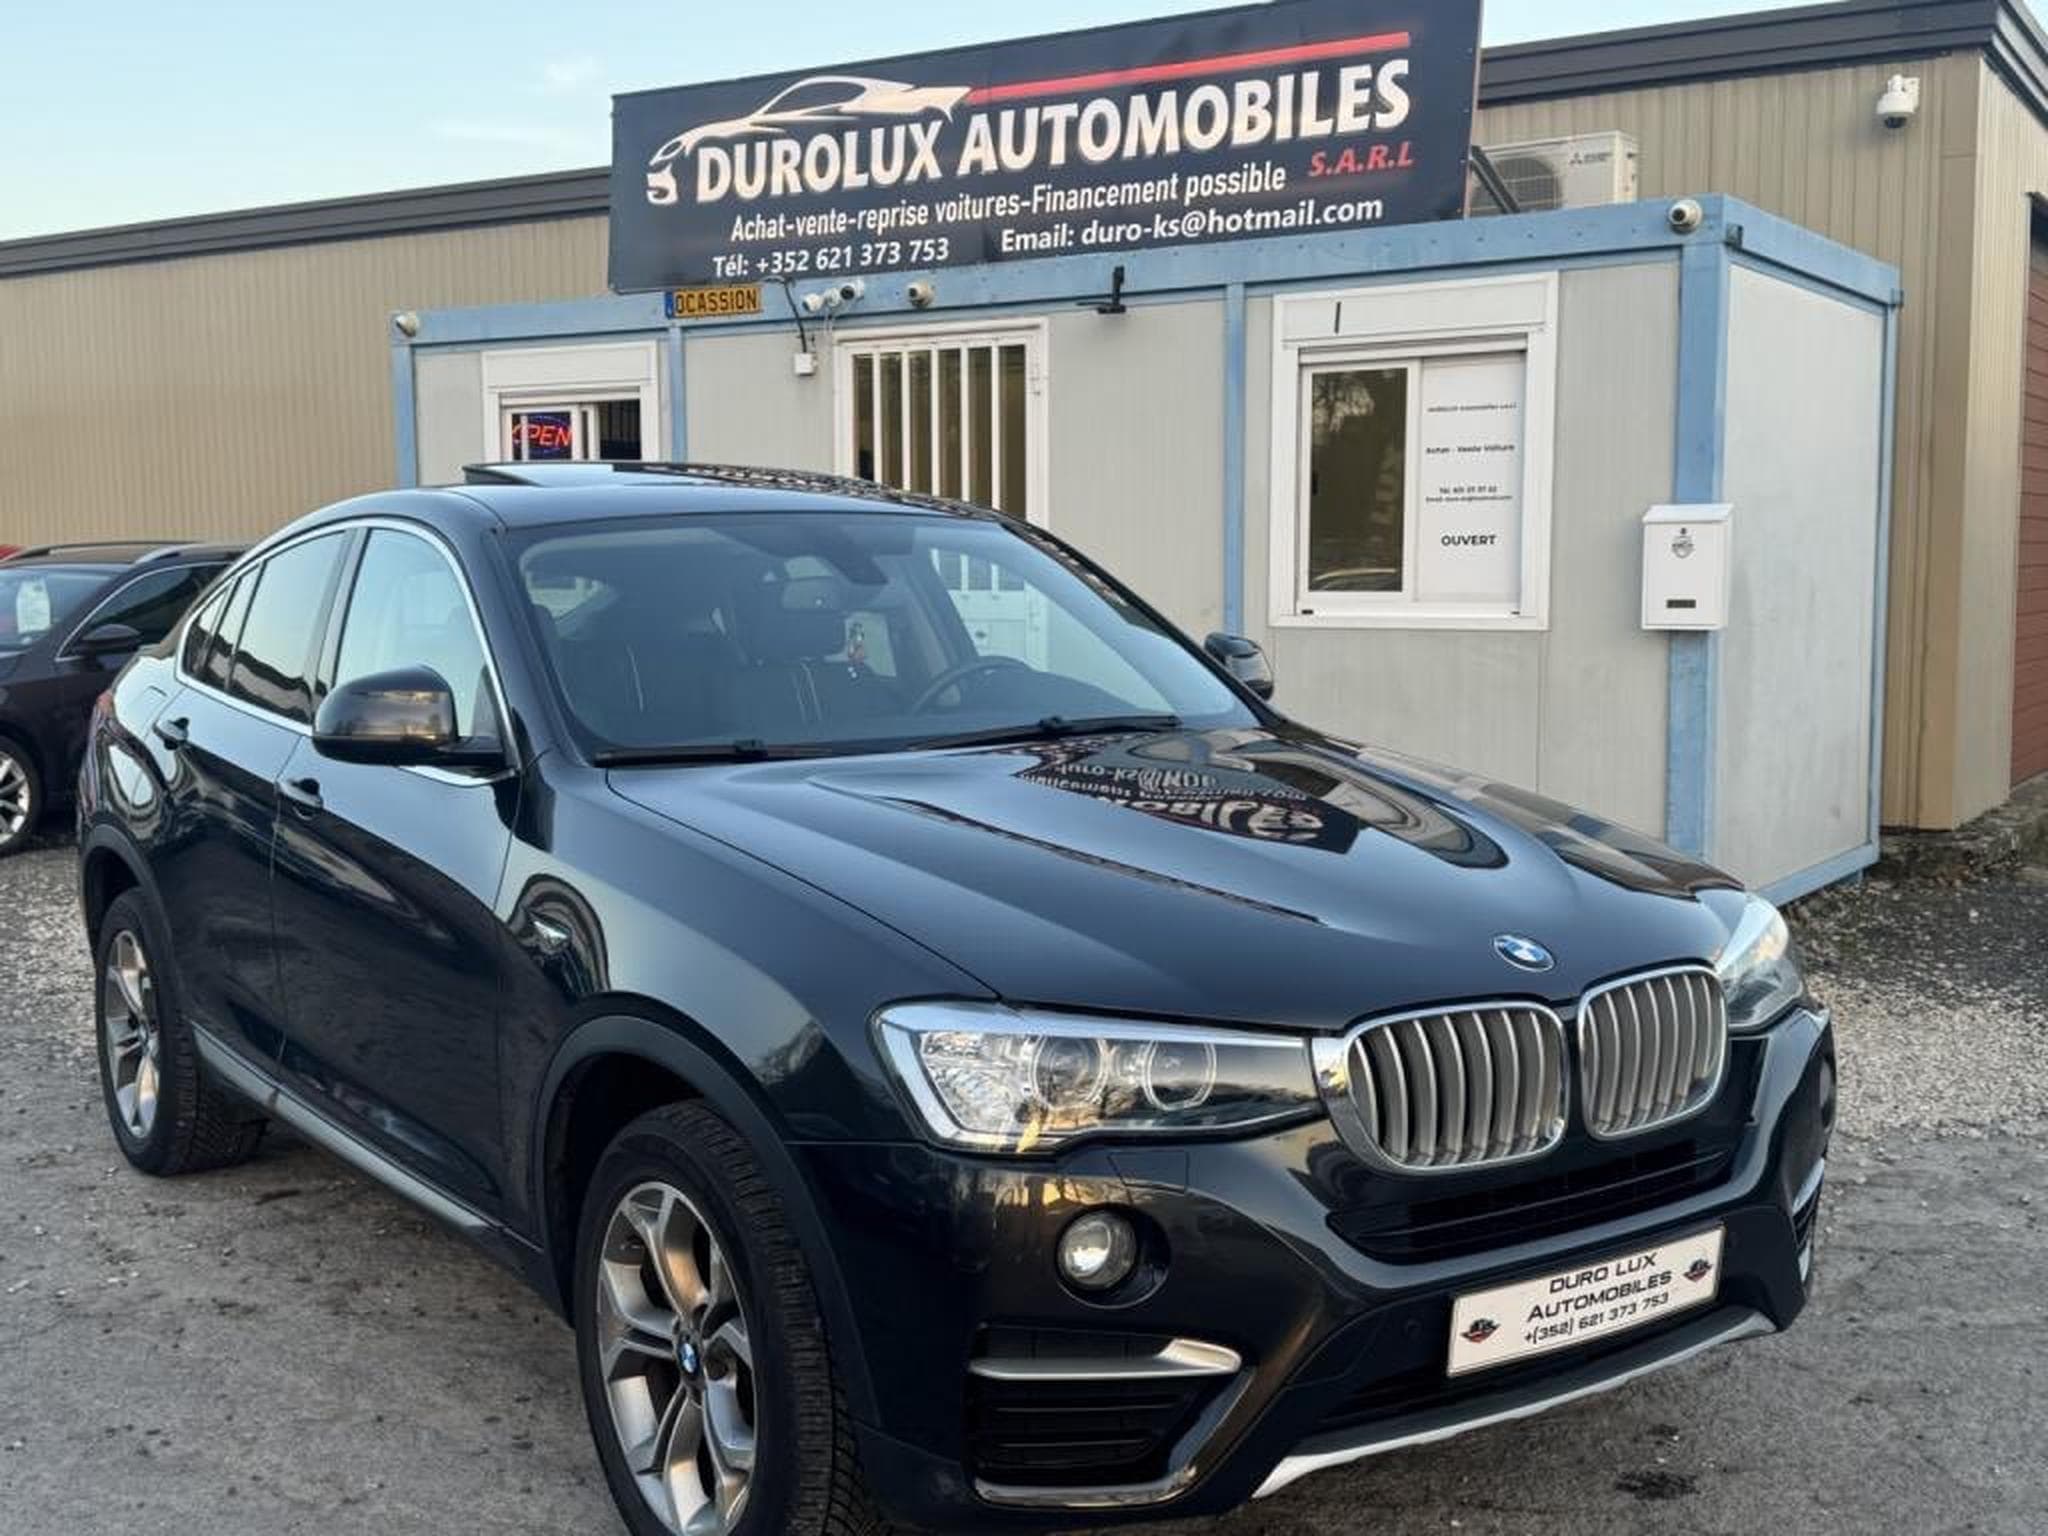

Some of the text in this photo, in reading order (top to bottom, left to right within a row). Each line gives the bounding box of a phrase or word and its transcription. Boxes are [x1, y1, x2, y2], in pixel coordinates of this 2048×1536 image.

[697, 58, 1410, 203] DUROLUX AUTOMOBILES
[1309, 141, 1415, 177] S.A.R.L
[731, 161, 1287, 242] Achat-vente-reprise voitures-Financement possible
[1001, 198, 1383, 252] Email: duro-ks@hotmail.com
[713, 237, 949, 278] Tél: +352 621 373 753
[675, 289, 757, 314] OCASSION
[1441, 534, 1496, 546] OUVERT
[1549, 1266, 1608, 1294] DURO
[1615, 1252, 1657, 1277] LUX
[1527, 1270, 1673, 1322] AUTOMOBILES
[1579, 1311, 1603, 1329] 621
[1609, 1304, 1637, 1322] 373
[1641, 1293, 1669, 1311] 753
